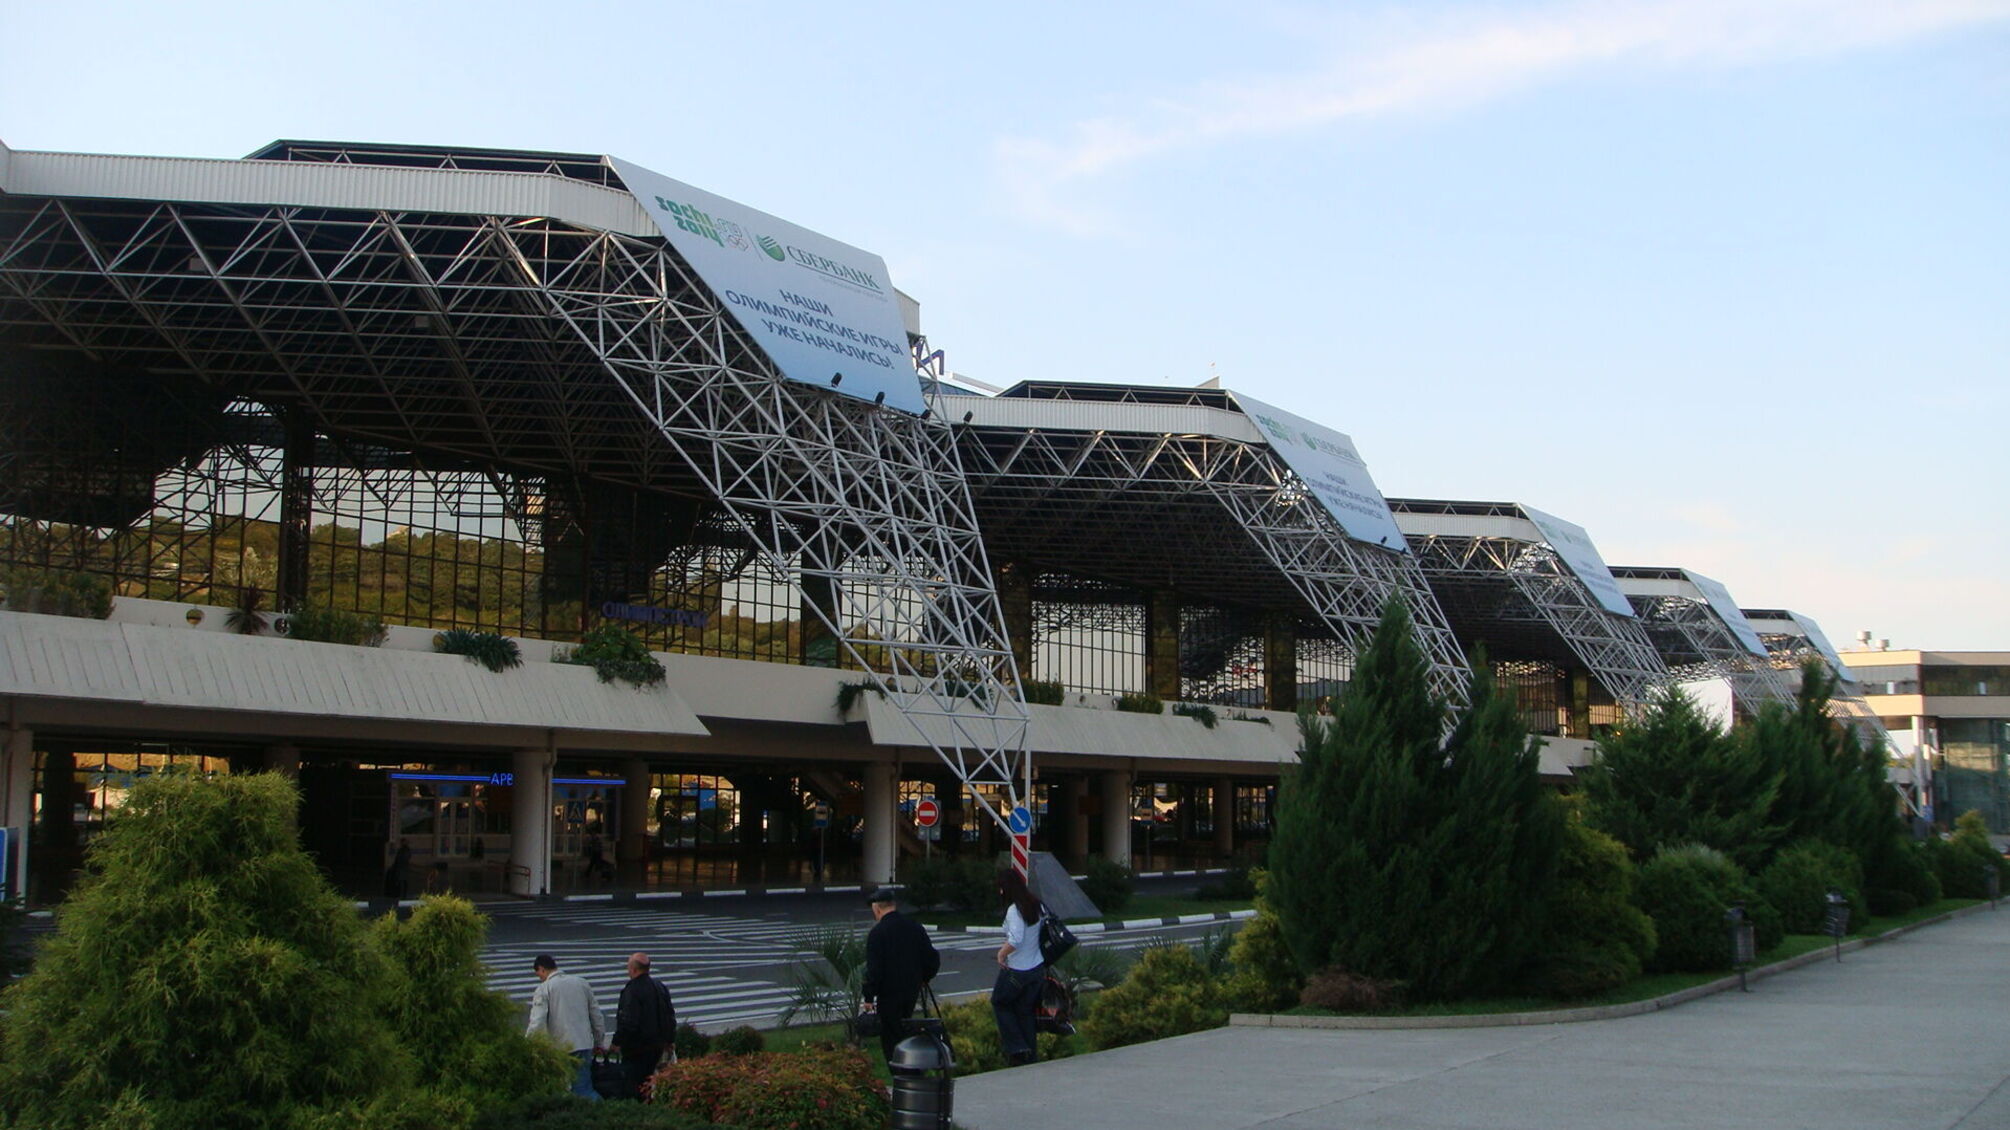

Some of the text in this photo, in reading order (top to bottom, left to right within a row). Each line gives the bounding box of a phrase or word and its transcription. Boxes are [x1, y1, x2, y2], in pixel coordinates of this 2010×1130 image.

[672, 214, 725, 248] 2014
[787, 245, 880, 289] СБЕРБАНК
[725, 290, 903, 356] ОЛИМПИЙСКИЕ ИГРЫ
[780, 289, 833, 317] НАШИ
[761, 318, 895, 370] УЖЕ НАЧАЛИСЬ!
